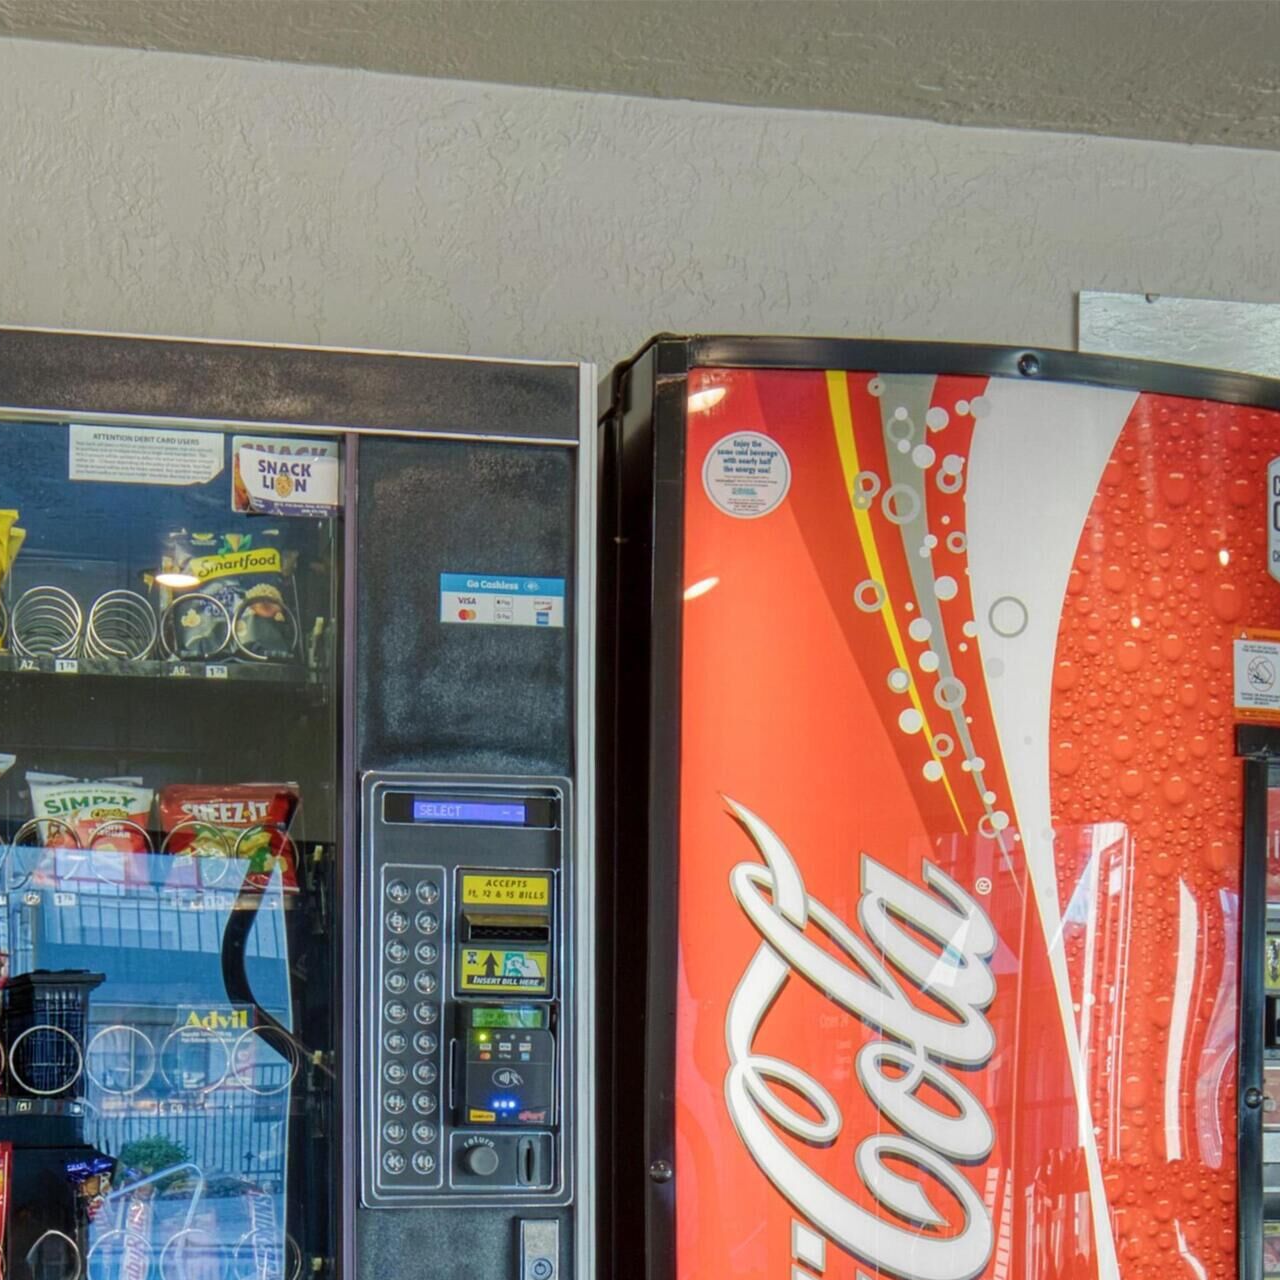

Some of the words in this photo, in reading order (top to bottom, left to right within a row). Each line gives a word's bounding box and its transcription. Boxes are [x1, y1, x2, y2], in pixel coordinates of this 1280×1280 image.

[93, 433, 133, 442] ATTENTION
[258, 459, 312, 478] SNACK
[198, 553, 278, 577] Smartfood
[467, 580, 479, 589] Go
[480, 581, 518, 590] Cashless
[458, 597, 476, 605] VISA
[21, 661, 33, 670] A7
[44, 796, 136, 815] SIMPLY
[420, 805, 462, 816] SELECT
[485, 880, 527, 888] ACCEPTS
[496, 890, 502, 898] &
[518, 891, 545, 900] BILLS
[473, 976, 500, 985] INSERT
[501, 977, 518, 986] BILL
[519, 979, 539, 987] HERE
[186, 1010, 248, 1029] Advil
[464, 1136, 495, 1148] return
